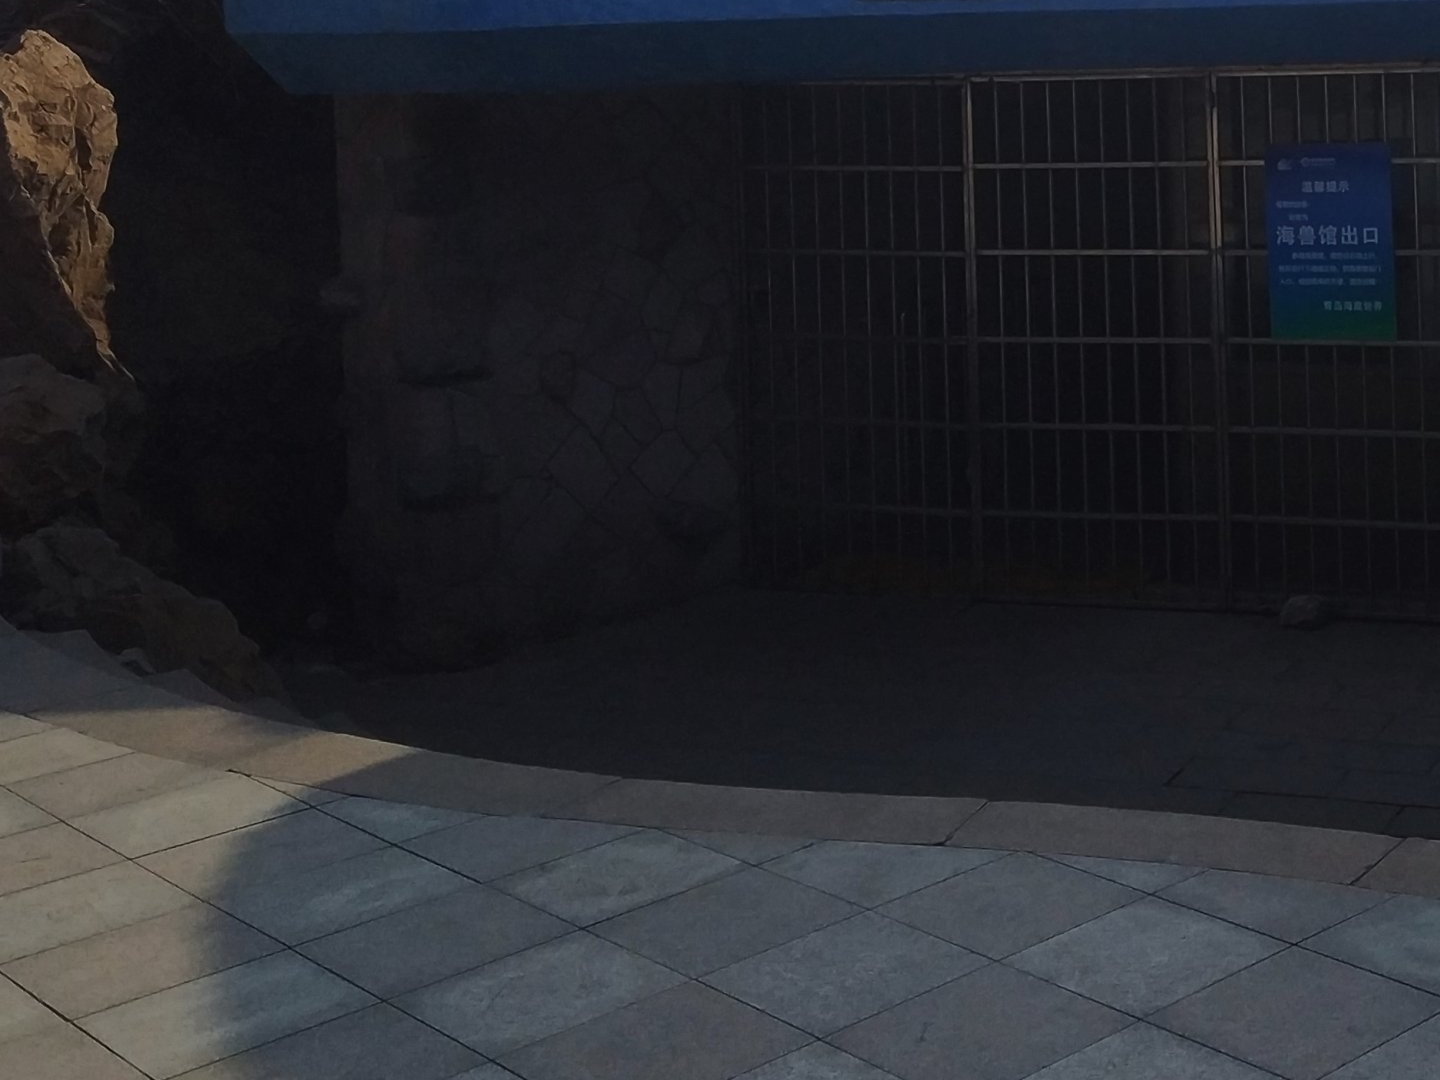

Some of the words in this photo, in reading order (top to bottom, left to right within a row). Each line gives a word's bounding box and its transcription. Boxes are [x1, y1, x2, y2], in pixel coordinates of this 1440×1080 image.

[1276, 224, 1379, 246] 海兽馆出口
